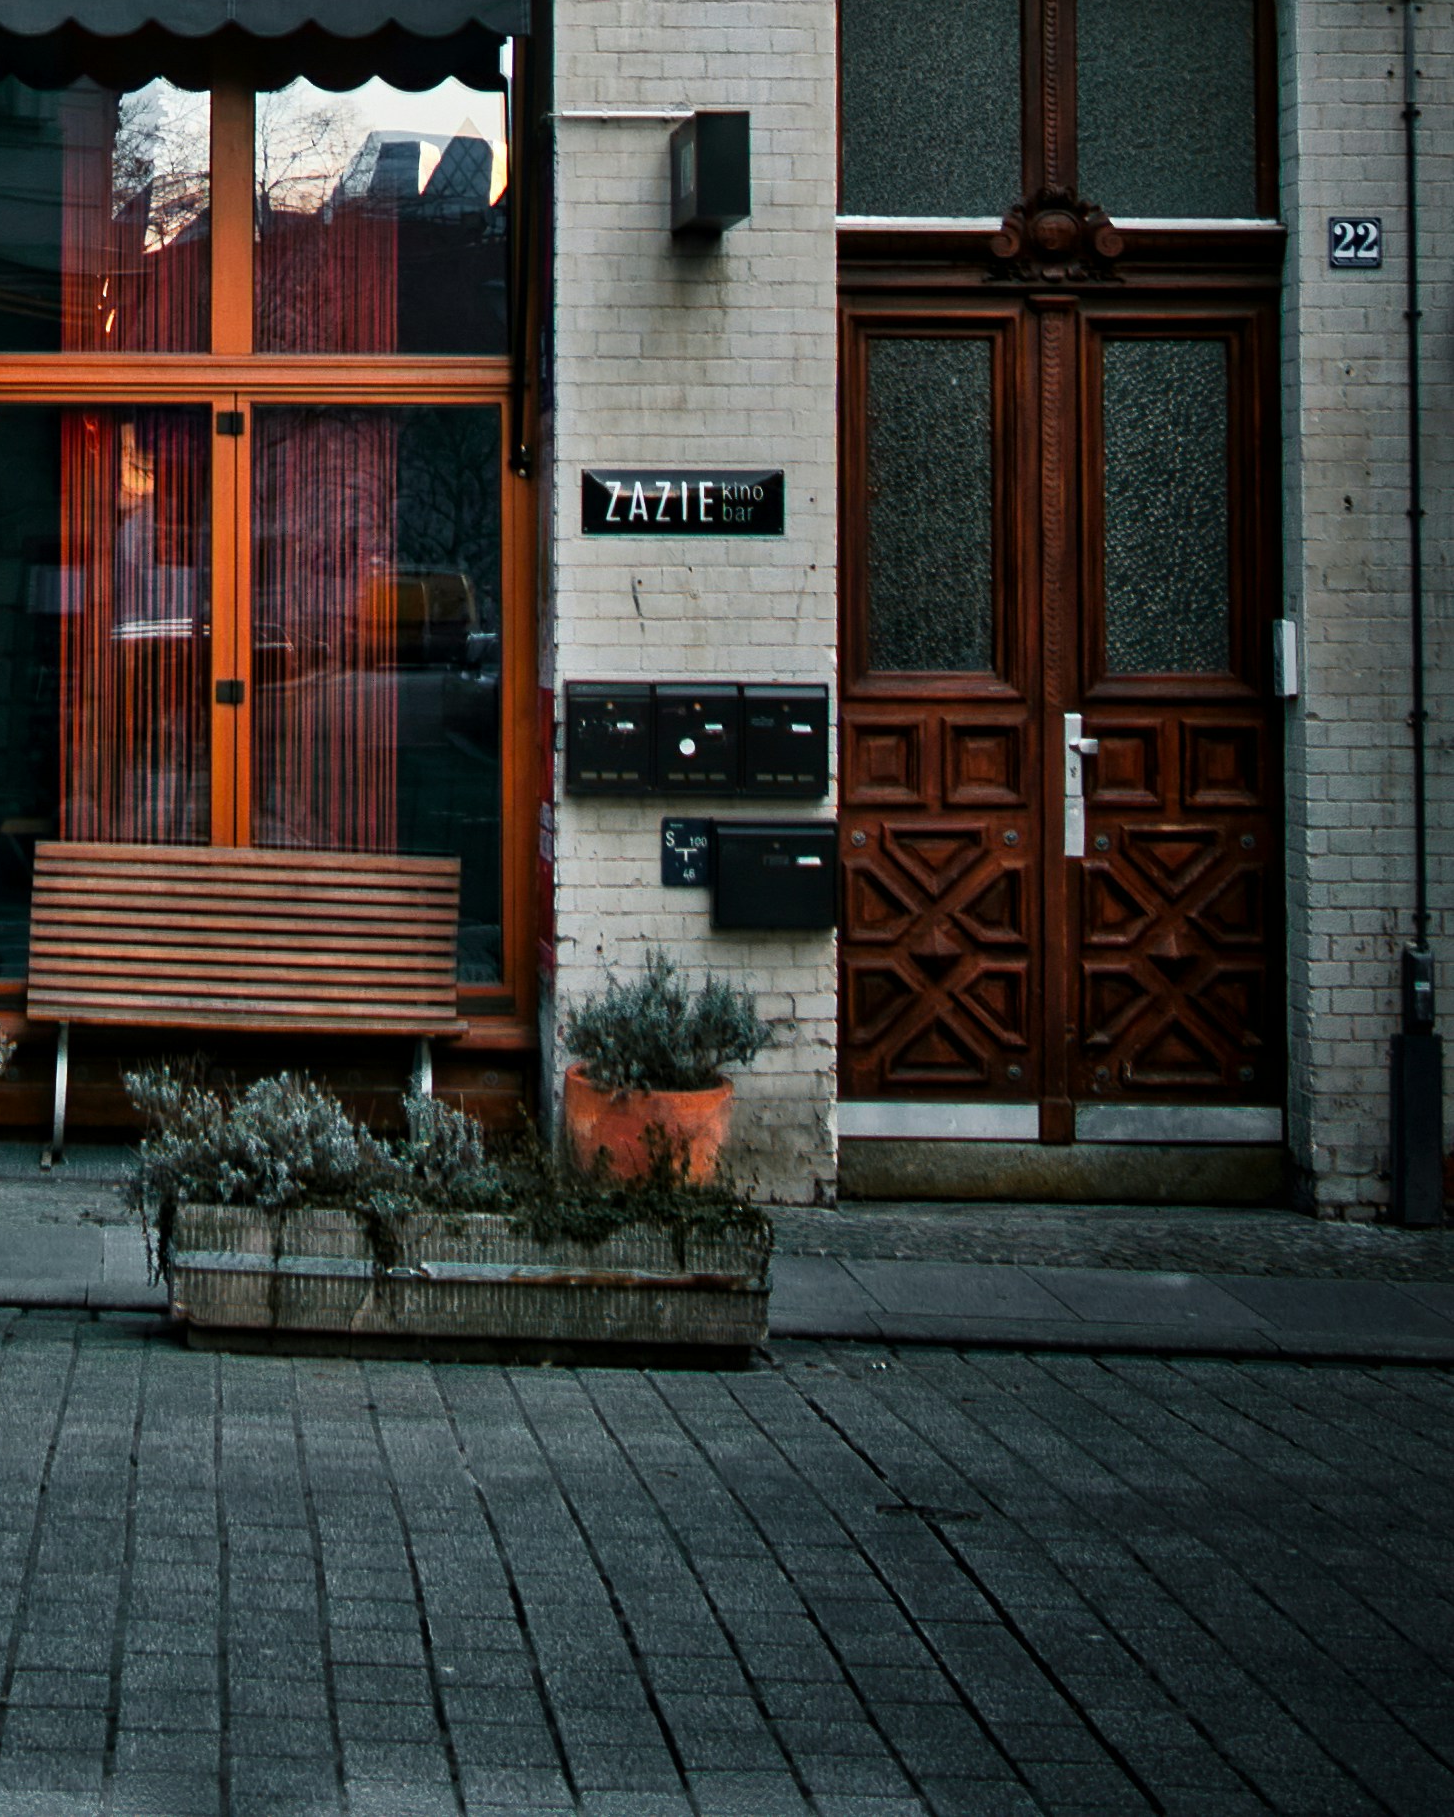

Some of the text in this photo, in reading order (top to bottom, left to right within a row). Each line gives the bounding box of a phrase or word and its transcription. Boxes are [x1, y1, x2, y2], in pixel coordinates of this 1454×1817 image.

[1333, 222, 1379, 258] 22
[604, 480, 715, 523] ZAZIE
[721, 480, 765, 502] kino
[721, 502, 755, 523] bar
